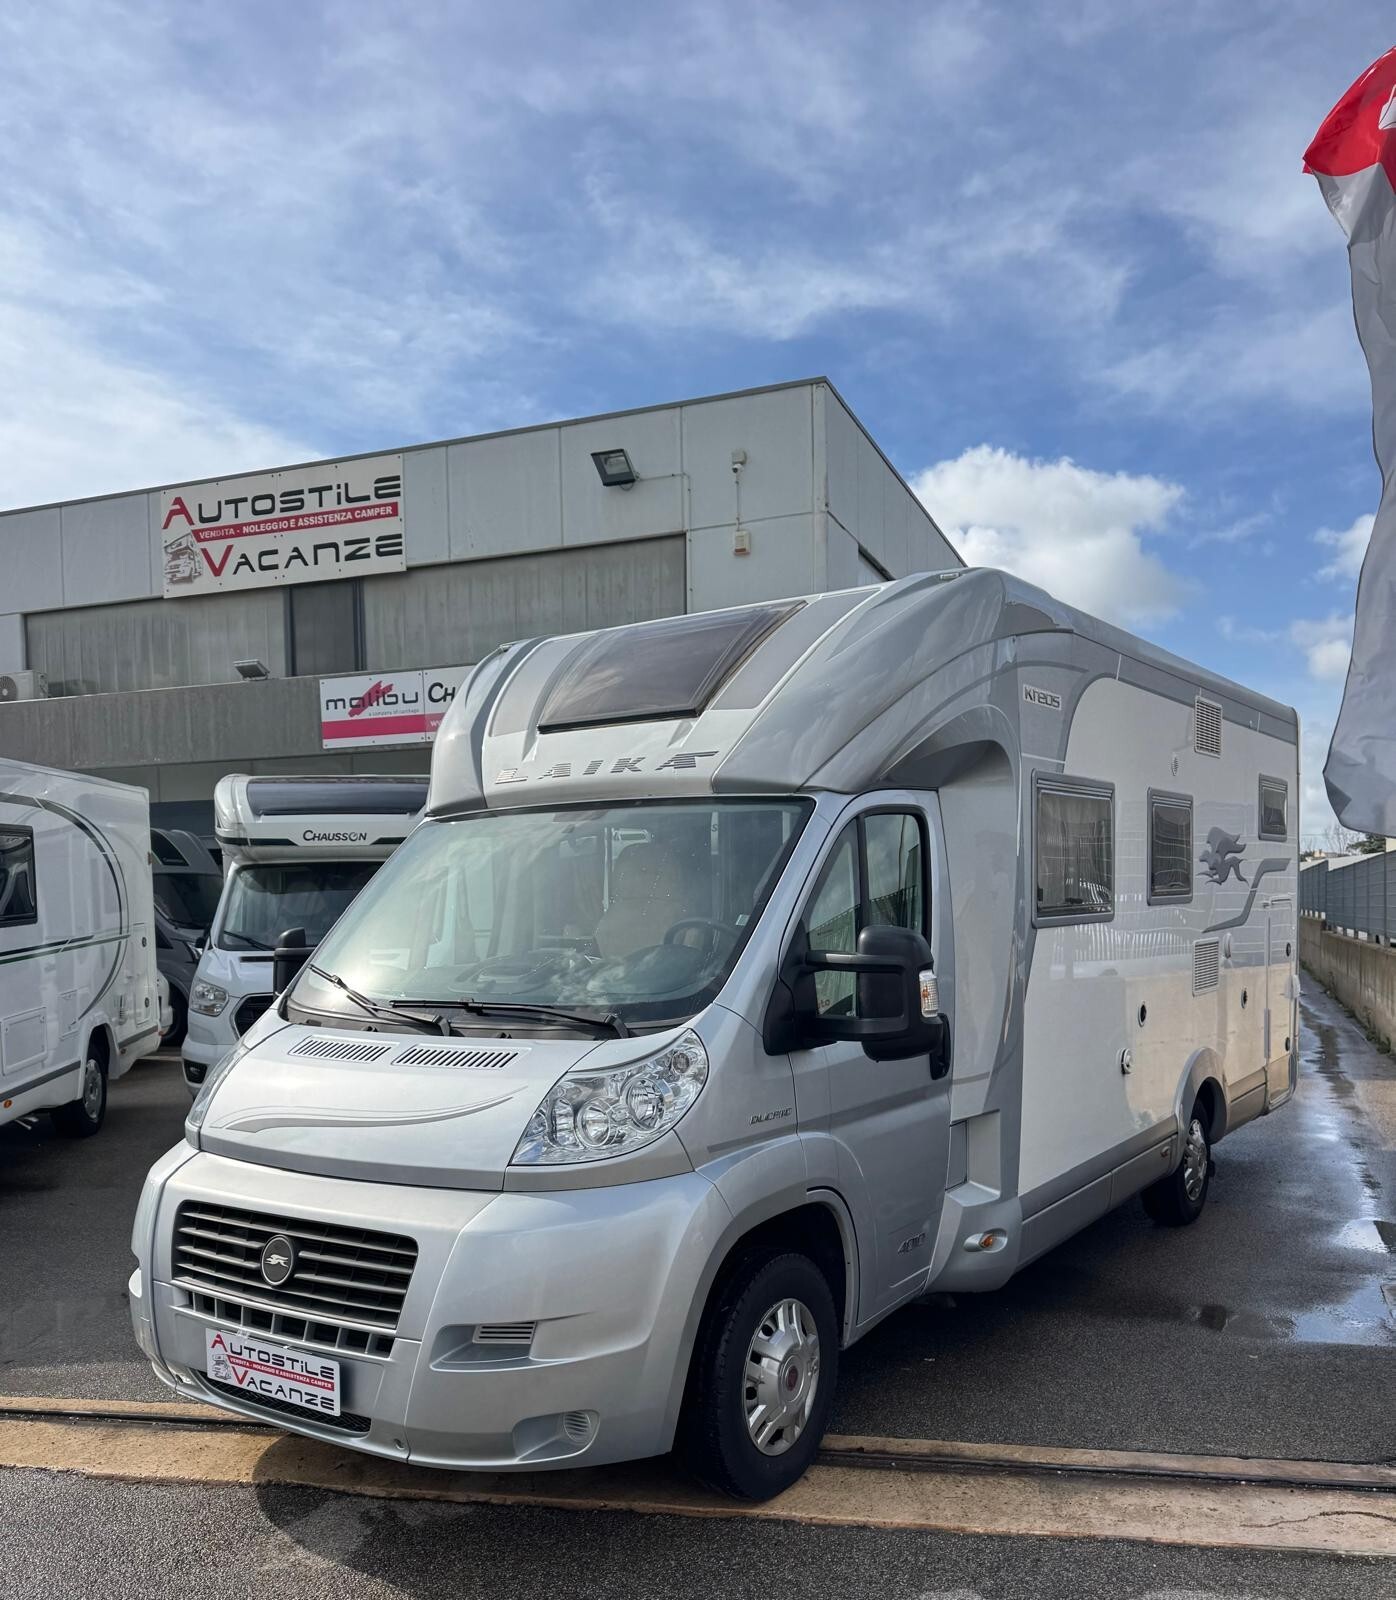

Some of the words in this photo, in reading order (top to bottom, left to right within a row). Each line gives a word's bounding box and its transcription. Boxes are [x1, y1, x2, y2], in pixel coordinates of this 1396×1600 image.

[199, 528, 235, 539] VENDITA
[243, 521, 288, 534] NOLEGGIO
[290, 518, 296, 528] E
[298, 512, 353, 526] ASSISTENZA
[354, 505, 392, 518] CAMPER
[495, 750, 719, 785] LAIKA
[303, 829, 367, 841] CHAUSSON
[311, 1379, 332, 1389] CAMPER
